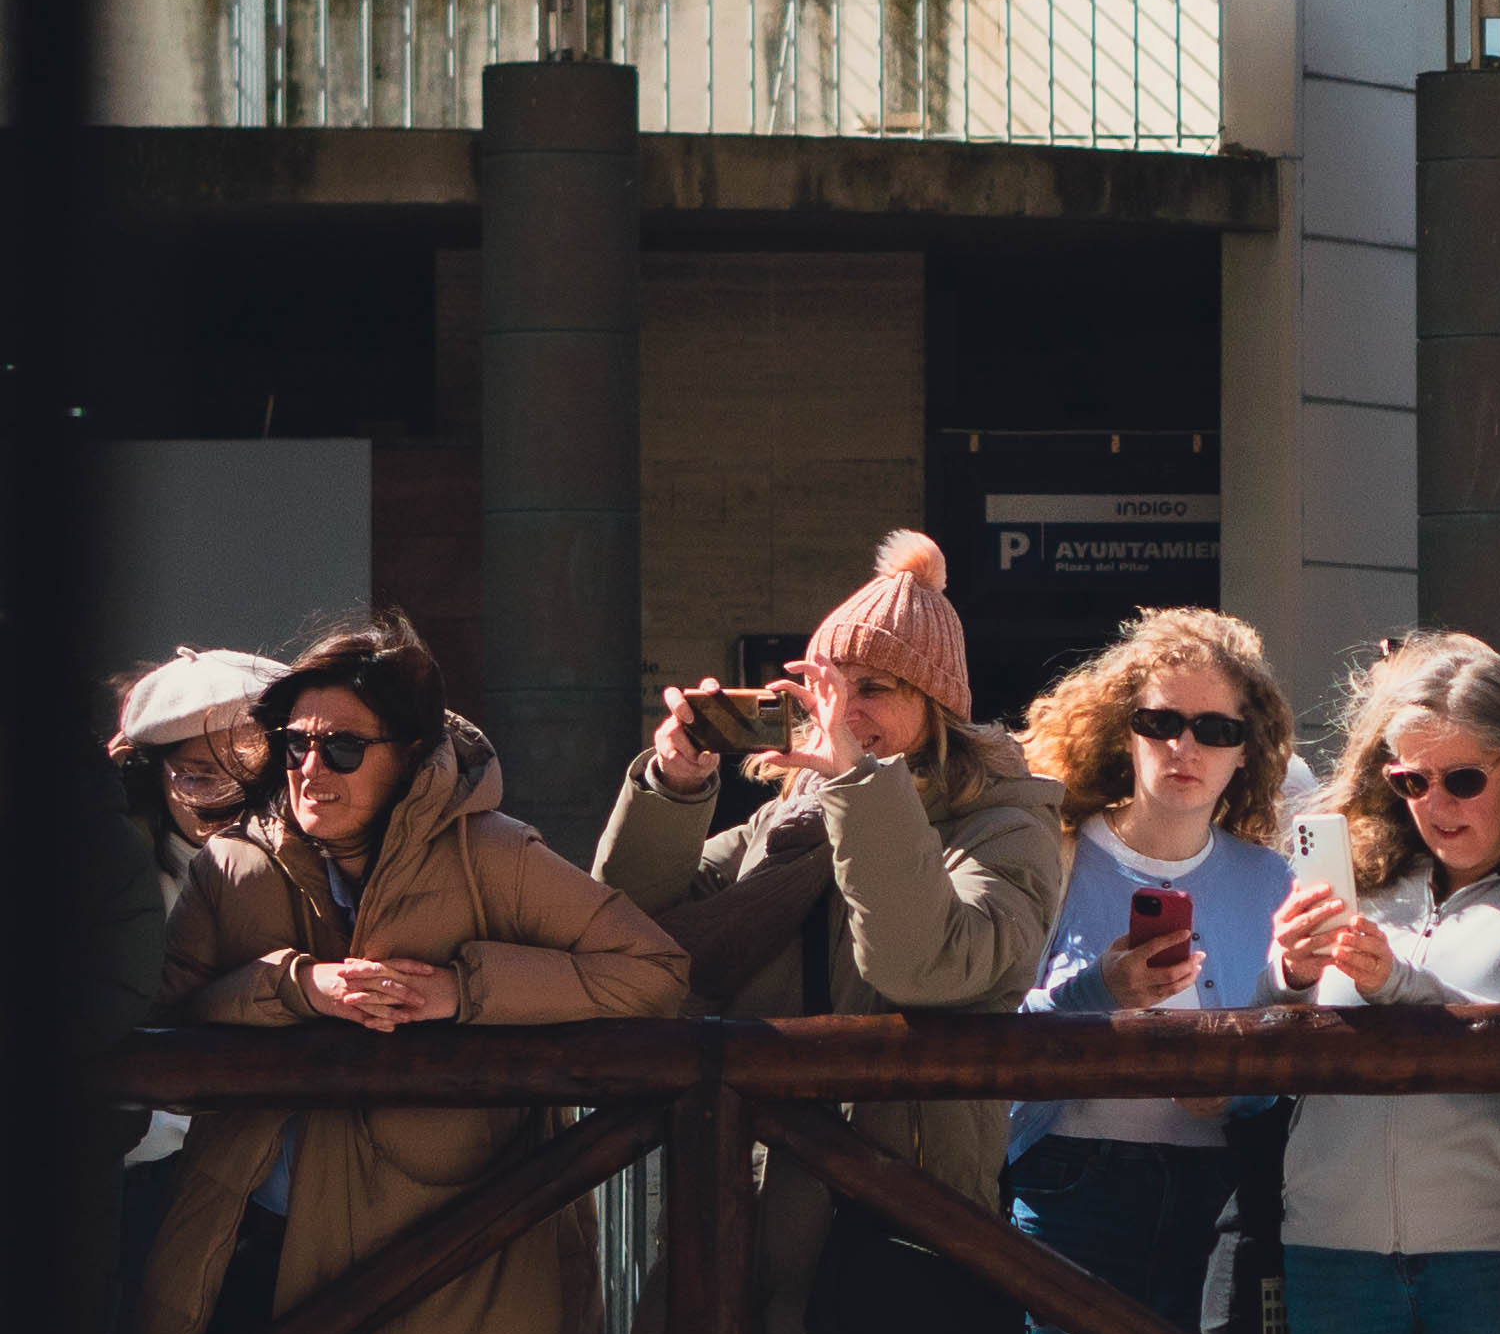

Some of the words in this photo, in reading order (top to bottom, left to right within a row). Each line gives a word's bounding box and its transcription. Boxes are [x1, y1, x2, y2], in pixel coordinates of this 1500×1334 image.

[1000, 531, 1031, 571] P
[1055, 541, 1220, 559] AYUNTAMIEN
[1055, 562, 1091, 572] Plaza
[1096, 562, 1115, 572] del
[1119, 562, 1150, 572] Pilar
